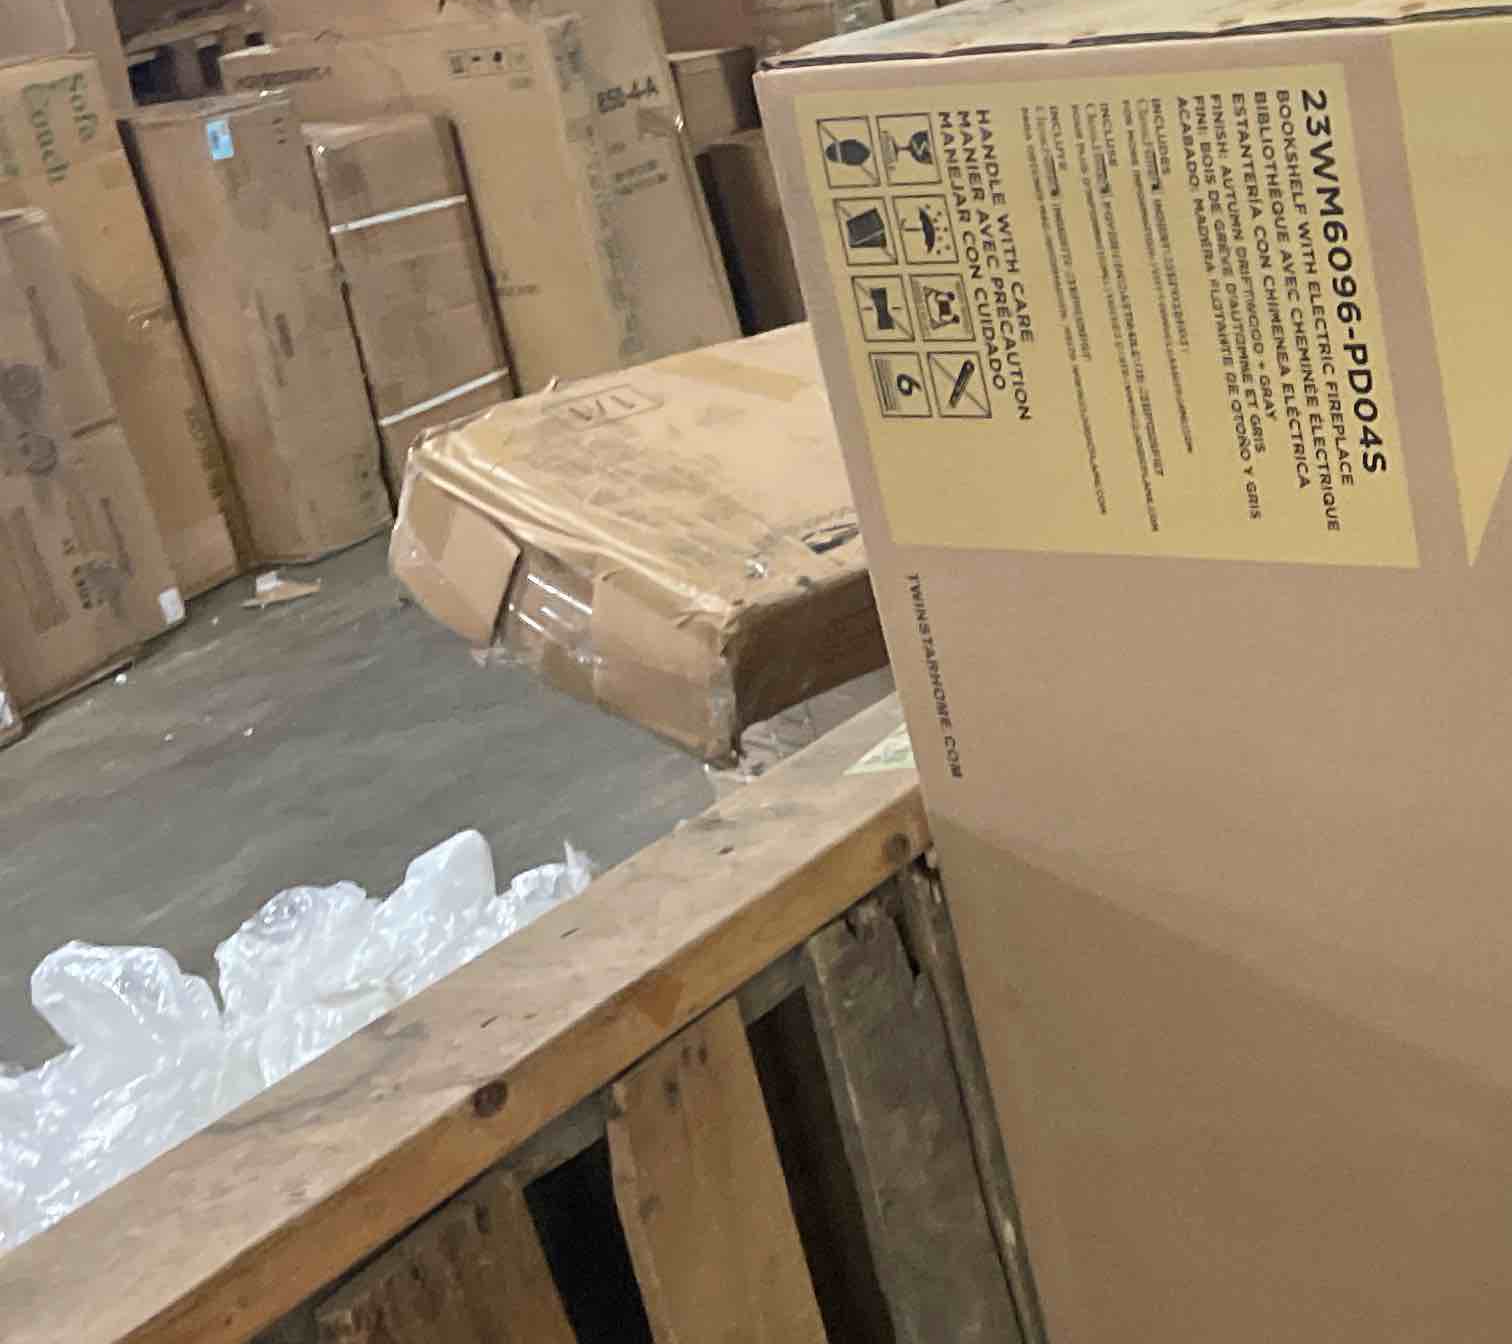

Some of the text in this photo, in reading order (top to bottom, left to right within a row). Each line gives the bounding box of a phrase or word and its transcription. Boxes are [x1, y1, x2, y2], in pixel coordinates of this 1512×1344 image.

[1148, 97, 1173, 175] INCLUDES
[1198, 141, 1218, 185] BOIS
[935, 111, 1007, 390] MANEJAR CON CUIDADO
[974, 109, 1035, 343] HANDLE WITH CARE
[1206, 189, 1222, 211] DE
[1252, 224, 1273, 269] CON
[955, 110, 1035, 420] MANIER AVEC PRÉCAUTION
[1207, 93, 1231, 159] FINISH:
[1219, 164, 1244, 241] AUTUMN
[1257, 374, 1278, 421] GRAY
[1273, 89, 1354, 486] BOOKSHELF WITH ELECTRIC FIREPLACE
[1279, 249, 1300, 302] AVEC
[1300, 87, 1387, 474] 23WM6096-PD04S
[1192, 197, 1217, 271] MADERA
[1243, 480, 1263, 521] GRIS
[1261, 274, 1291, 376] CHIMENEA
[1243, 388, 1259, 409] ET
[1248, 413, 1267, 454] GRIS
[1281, 382, 1314, 489] ELÉCTRICA
[907, 573, 962, 778] TWINSTARHOME.COM
